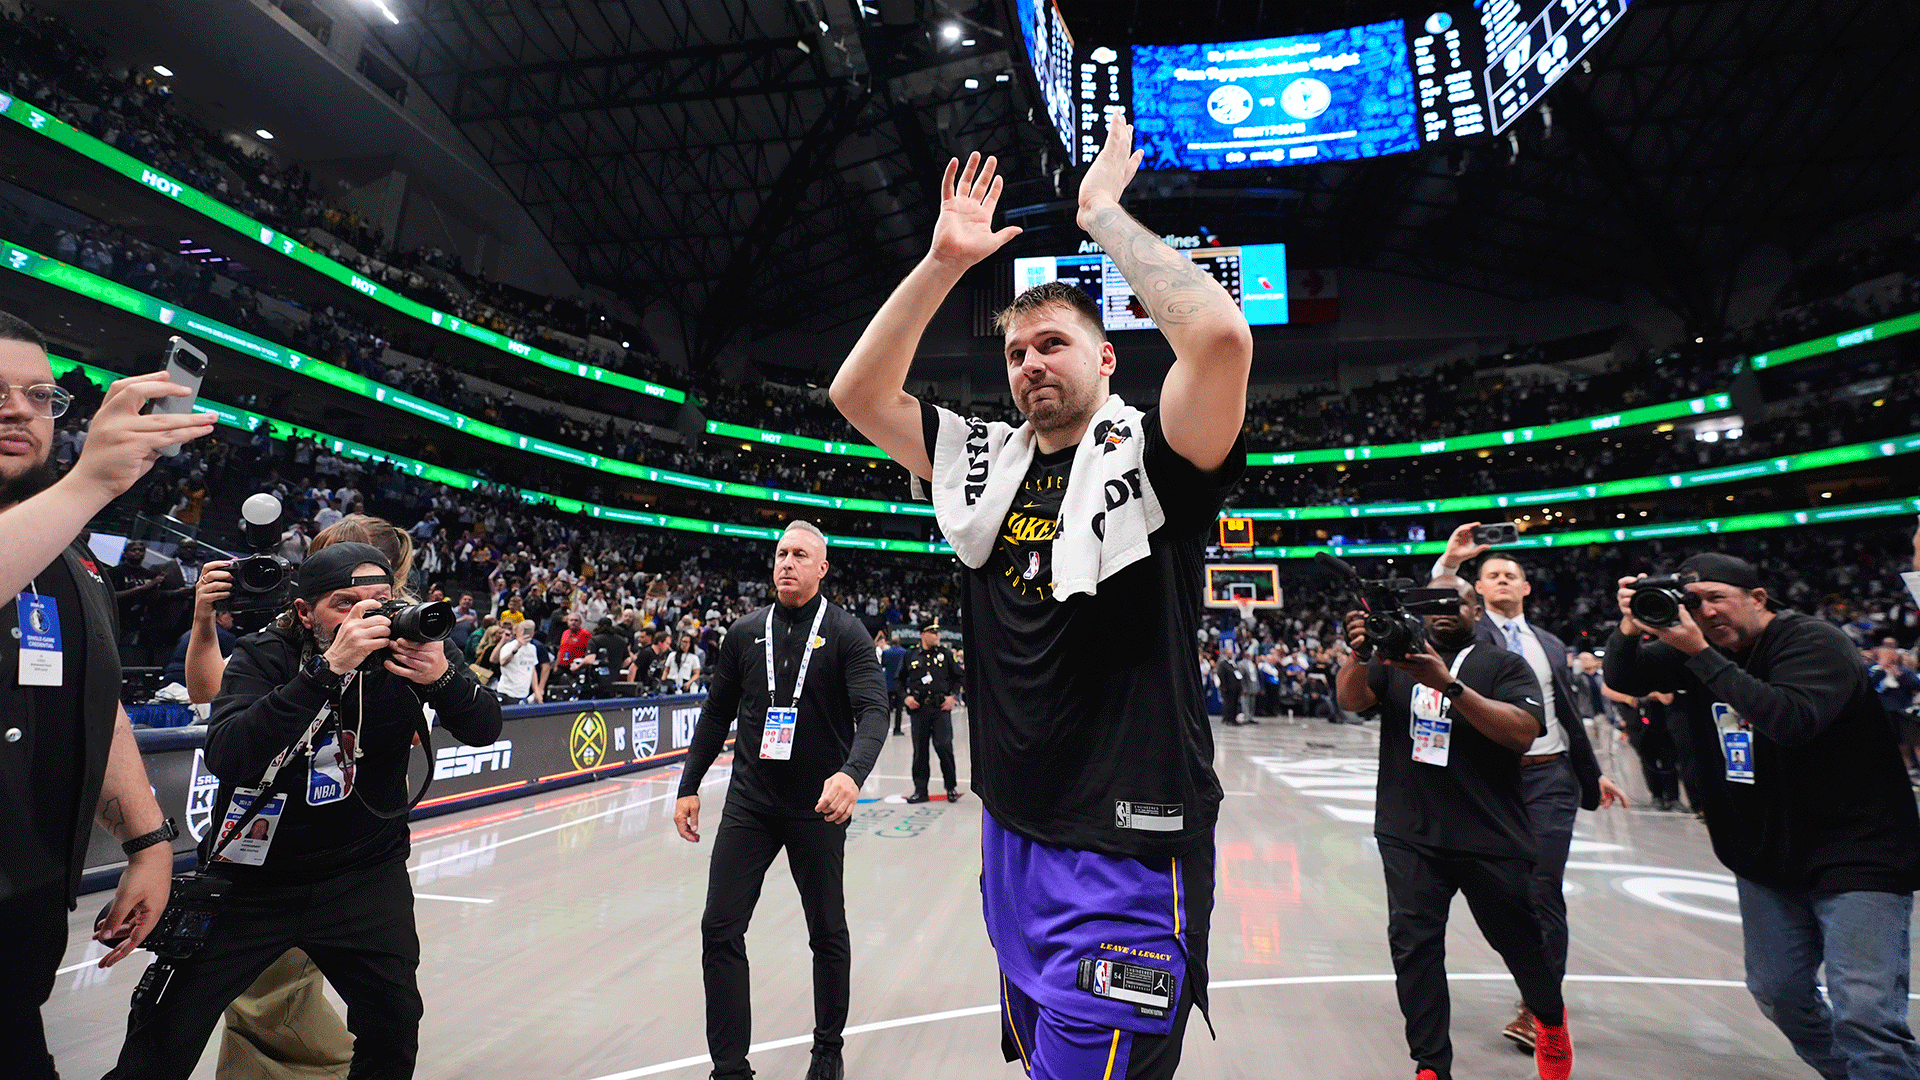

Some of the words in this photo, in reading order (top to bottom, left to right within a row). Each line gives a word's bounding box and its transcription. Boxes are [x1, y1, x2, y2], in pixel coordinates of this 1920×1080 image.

[141, 169, 183, 198] HOT
[350, 275, 378, 297] HOT
[507, 340, 531, 356] HOT
[644, 384, 666, 398] HOT
[760, 432, 783, 444] HOT
[433, 739, 513, 781] ESPN
[313, 784, 336, 800] NBA
[1100, 942, 1130, 954] LEAVE
[1129, 948, 1138, 956] A
[1137, 950, 1172, 962] LEGACY
